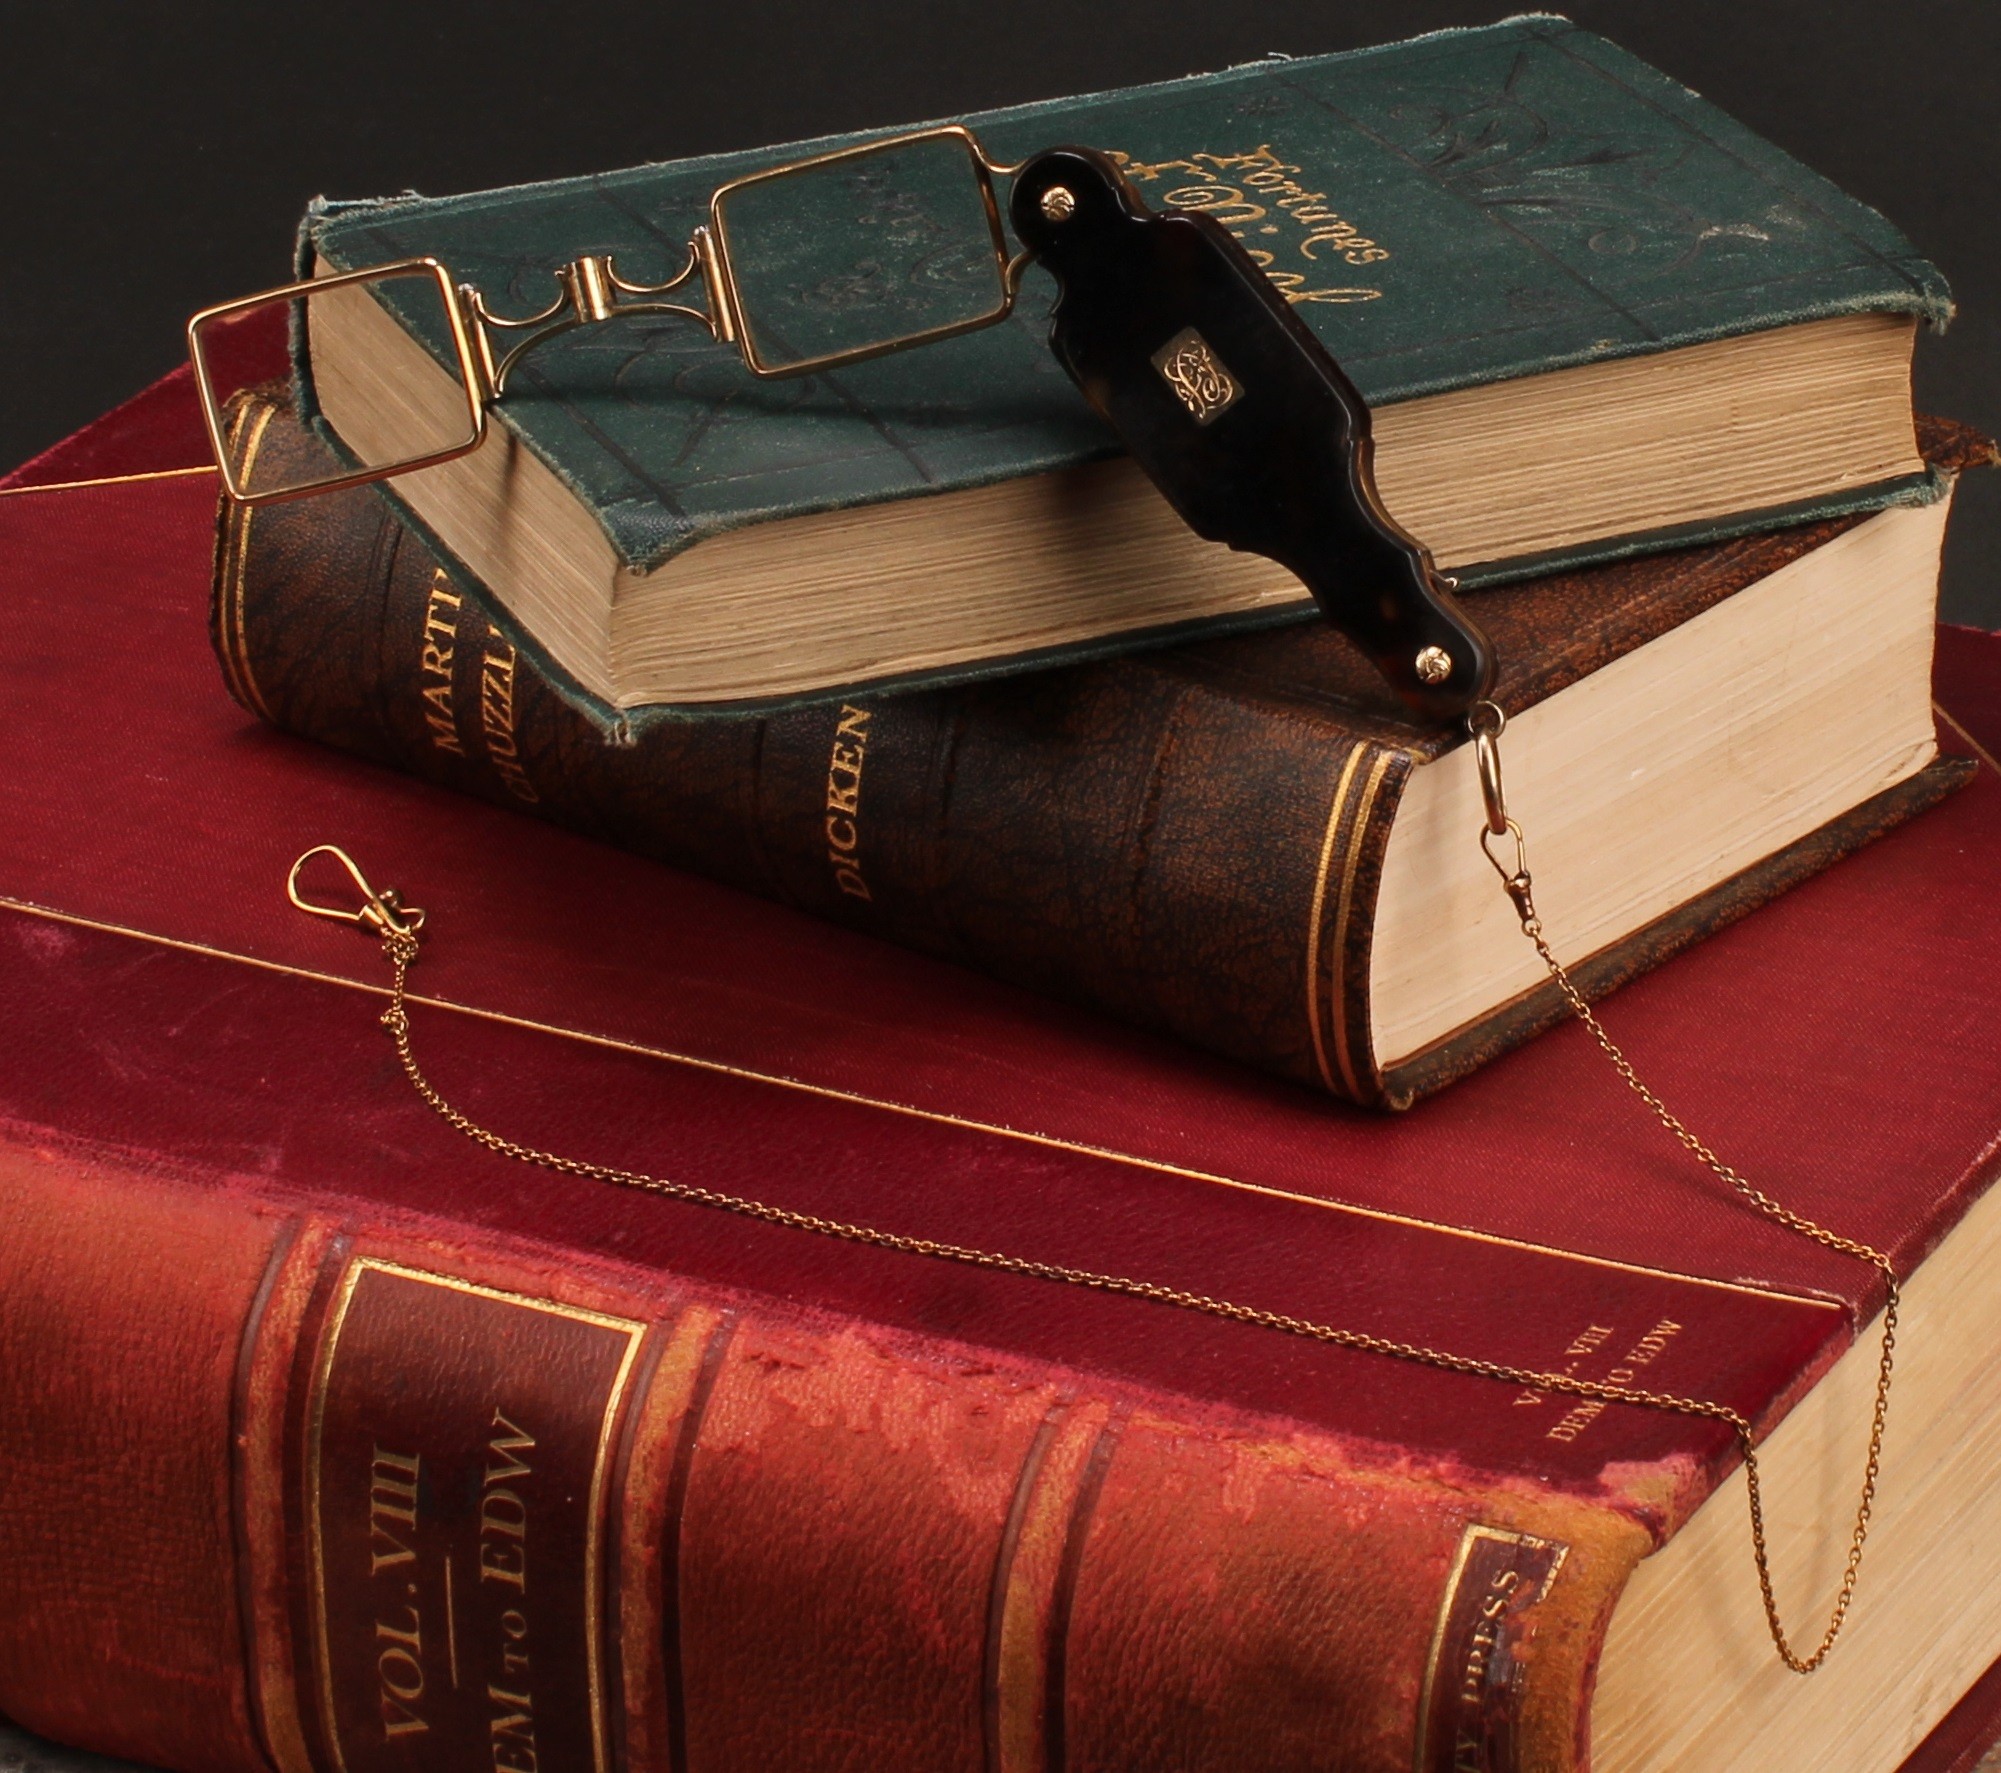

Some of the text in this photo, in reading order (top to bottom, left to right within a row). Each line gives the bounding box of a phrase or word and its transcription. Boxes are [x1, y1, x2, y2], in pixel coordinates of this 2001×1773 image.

[1192, 144, 1390, 266] Fortunes
[422, 566, 468, 758] MARTI
[481, 622, 540, 803] CHUZZL
[1546, 1400, 1610, 1442] DEM
[1623, 1318, 1683, 1365] EDW
[480, 1405, 536, 1595] EDW
